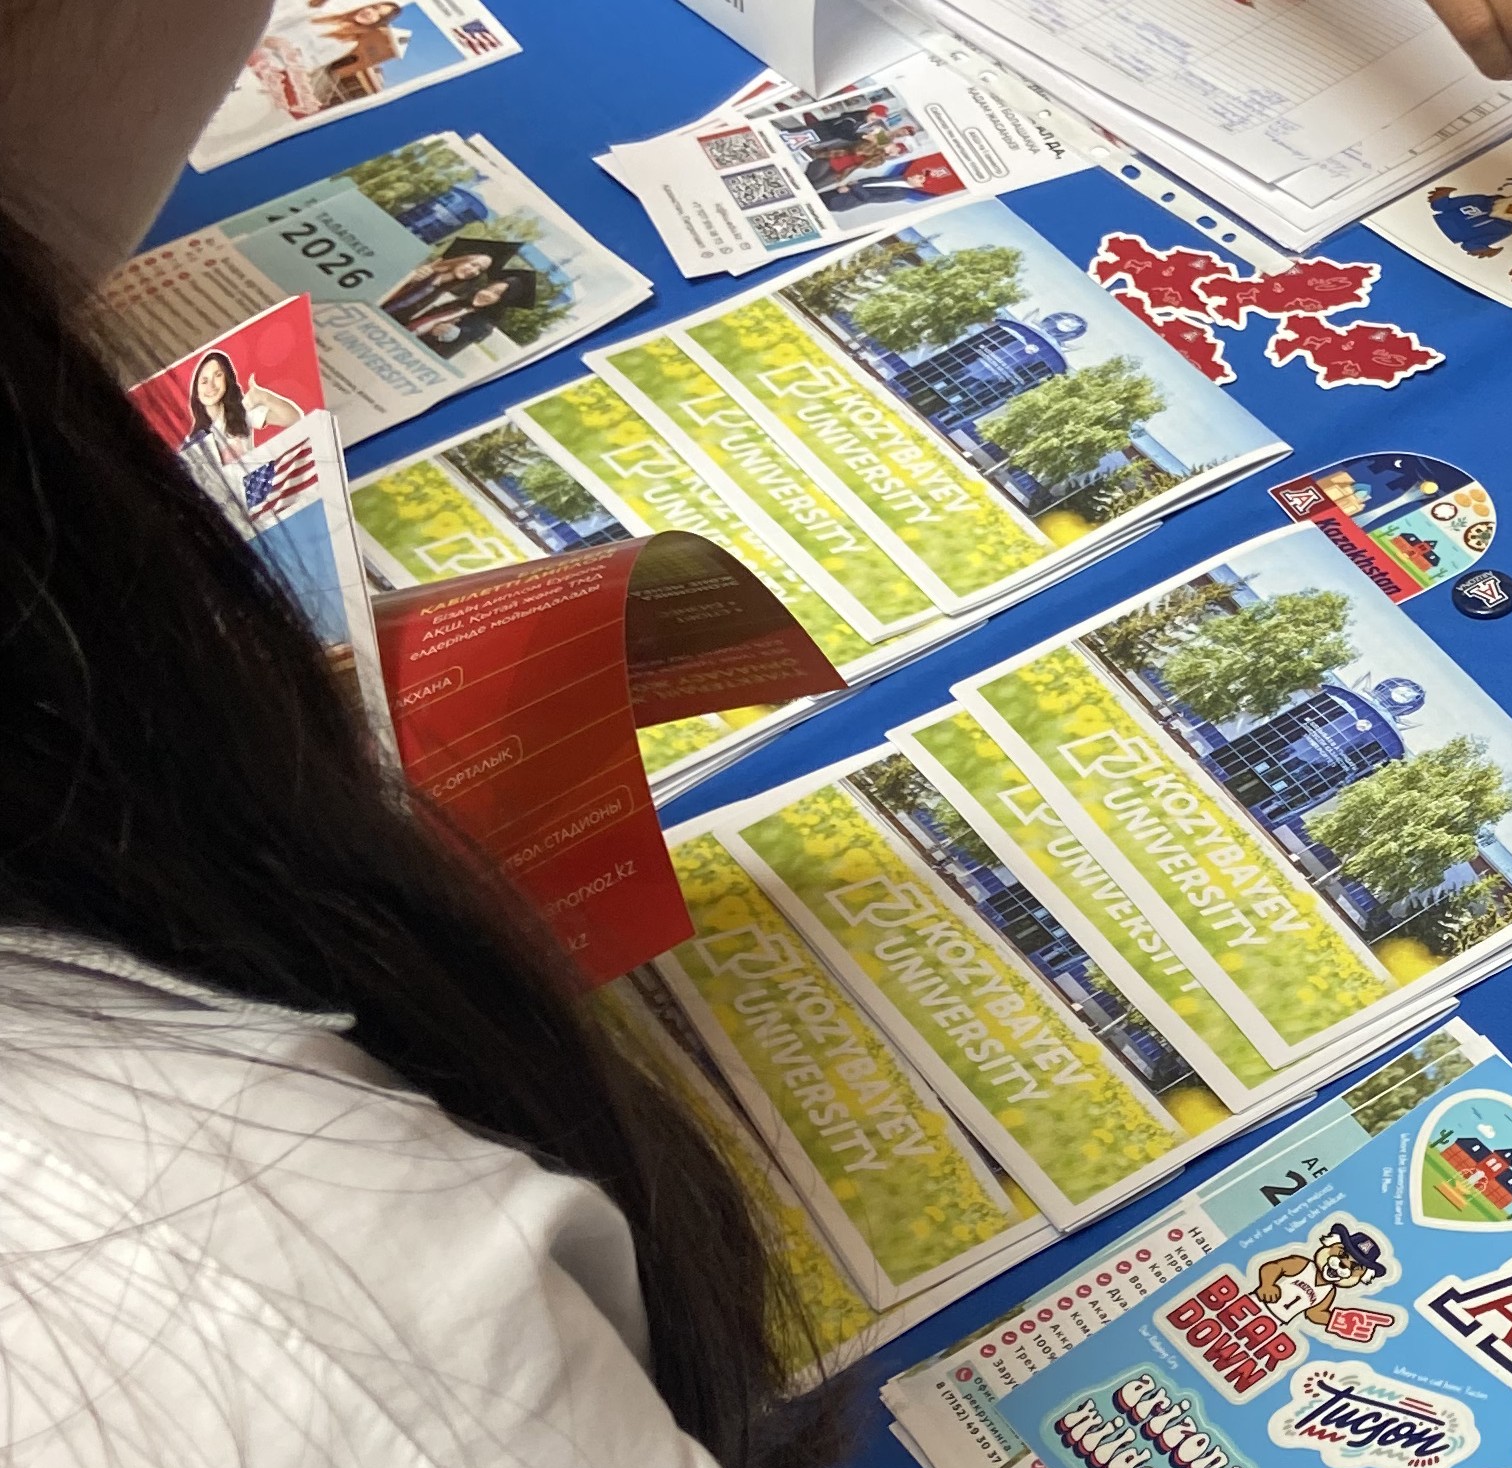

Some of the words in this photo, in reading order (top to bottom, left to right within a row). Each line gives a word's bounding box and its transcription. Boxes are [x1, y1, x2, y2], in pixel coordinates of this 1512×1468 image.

[282, 222, 374, 289] 2026
[334, 330, 423, 396] UNIVERSITY
[360, 315, 442, 386] KOZYBAYEV
[721, 435, 870, 557] UNIVERSITY
[797, 407, 942, 525] UNIVERSITY
[833, 390, 981, 514] KOZYBAYEV
[1314, 517, 1403, 596] Kazakhstan
[1455, 570, 1495, 593] ARIZONA
[544, 798, 622, 851] СТАДИОНЫ
[1102, 787, 1268, 950] UNIVERSITY
[1144, 774, 1311, 932] KOZYBAYEV
[874, 938, 1051, 1104] UNIVERSITY
[916, 921, 1098, 1086] KOZYBAYEV
[734, 990, 887, 1174] UNIVERSITY
[778, 977, 935, 1157] KOZYBAYEV
[1196, 1274, 1297, 1373] BEAR
[1292, 1279, 1315, 1305] ARIZONA
[1166, 1298, 1267, 1393] DOWN
[936, 1380, 943, 1390] 8
[942, 1388, 966, 1422] (7152)
[966, 1420, 979, 1436] 49
[978, 1435, 992, 1452] 30
[990, 1450, 1002, 1464] 37
[963, 1392, 1012, 1452] рекрутинга
